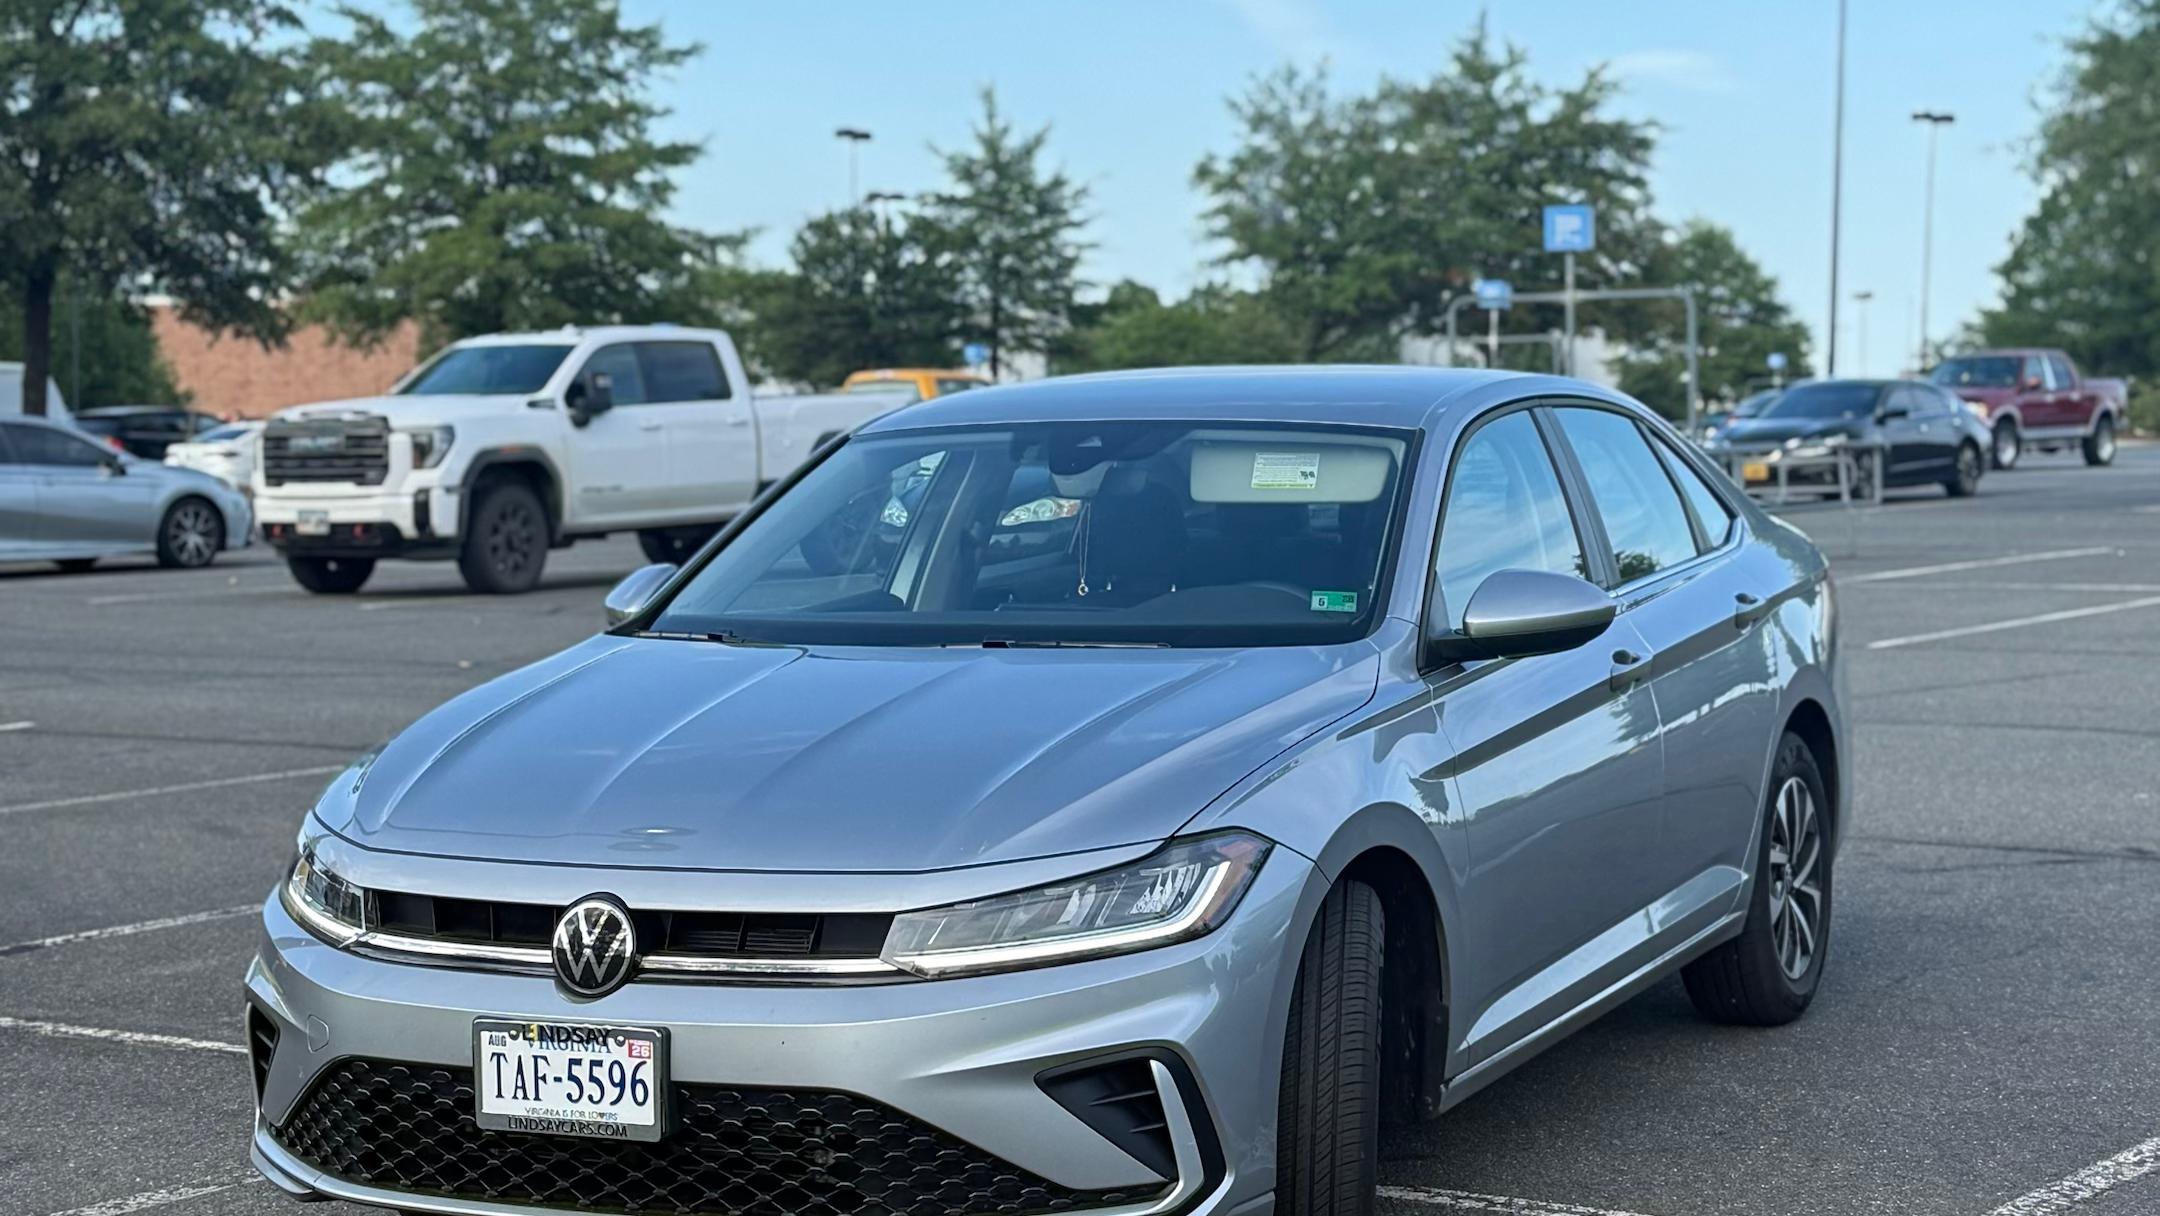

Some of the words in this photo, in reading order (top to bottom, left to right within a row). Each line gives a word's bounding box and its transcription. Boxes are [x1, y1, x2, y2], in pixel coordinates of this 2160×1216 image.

[488, 1033, 508, 1047] AUG
[523, 1023, 612, 1046] LINDSAY
[631, 1045, 650, 1058] 26
[490, 1052, 649, 1106] TAF-5596
[570, 1109, 587, 1119] FOR
[508, 1116, 628, 1138] LINDSAYCARS.COM
